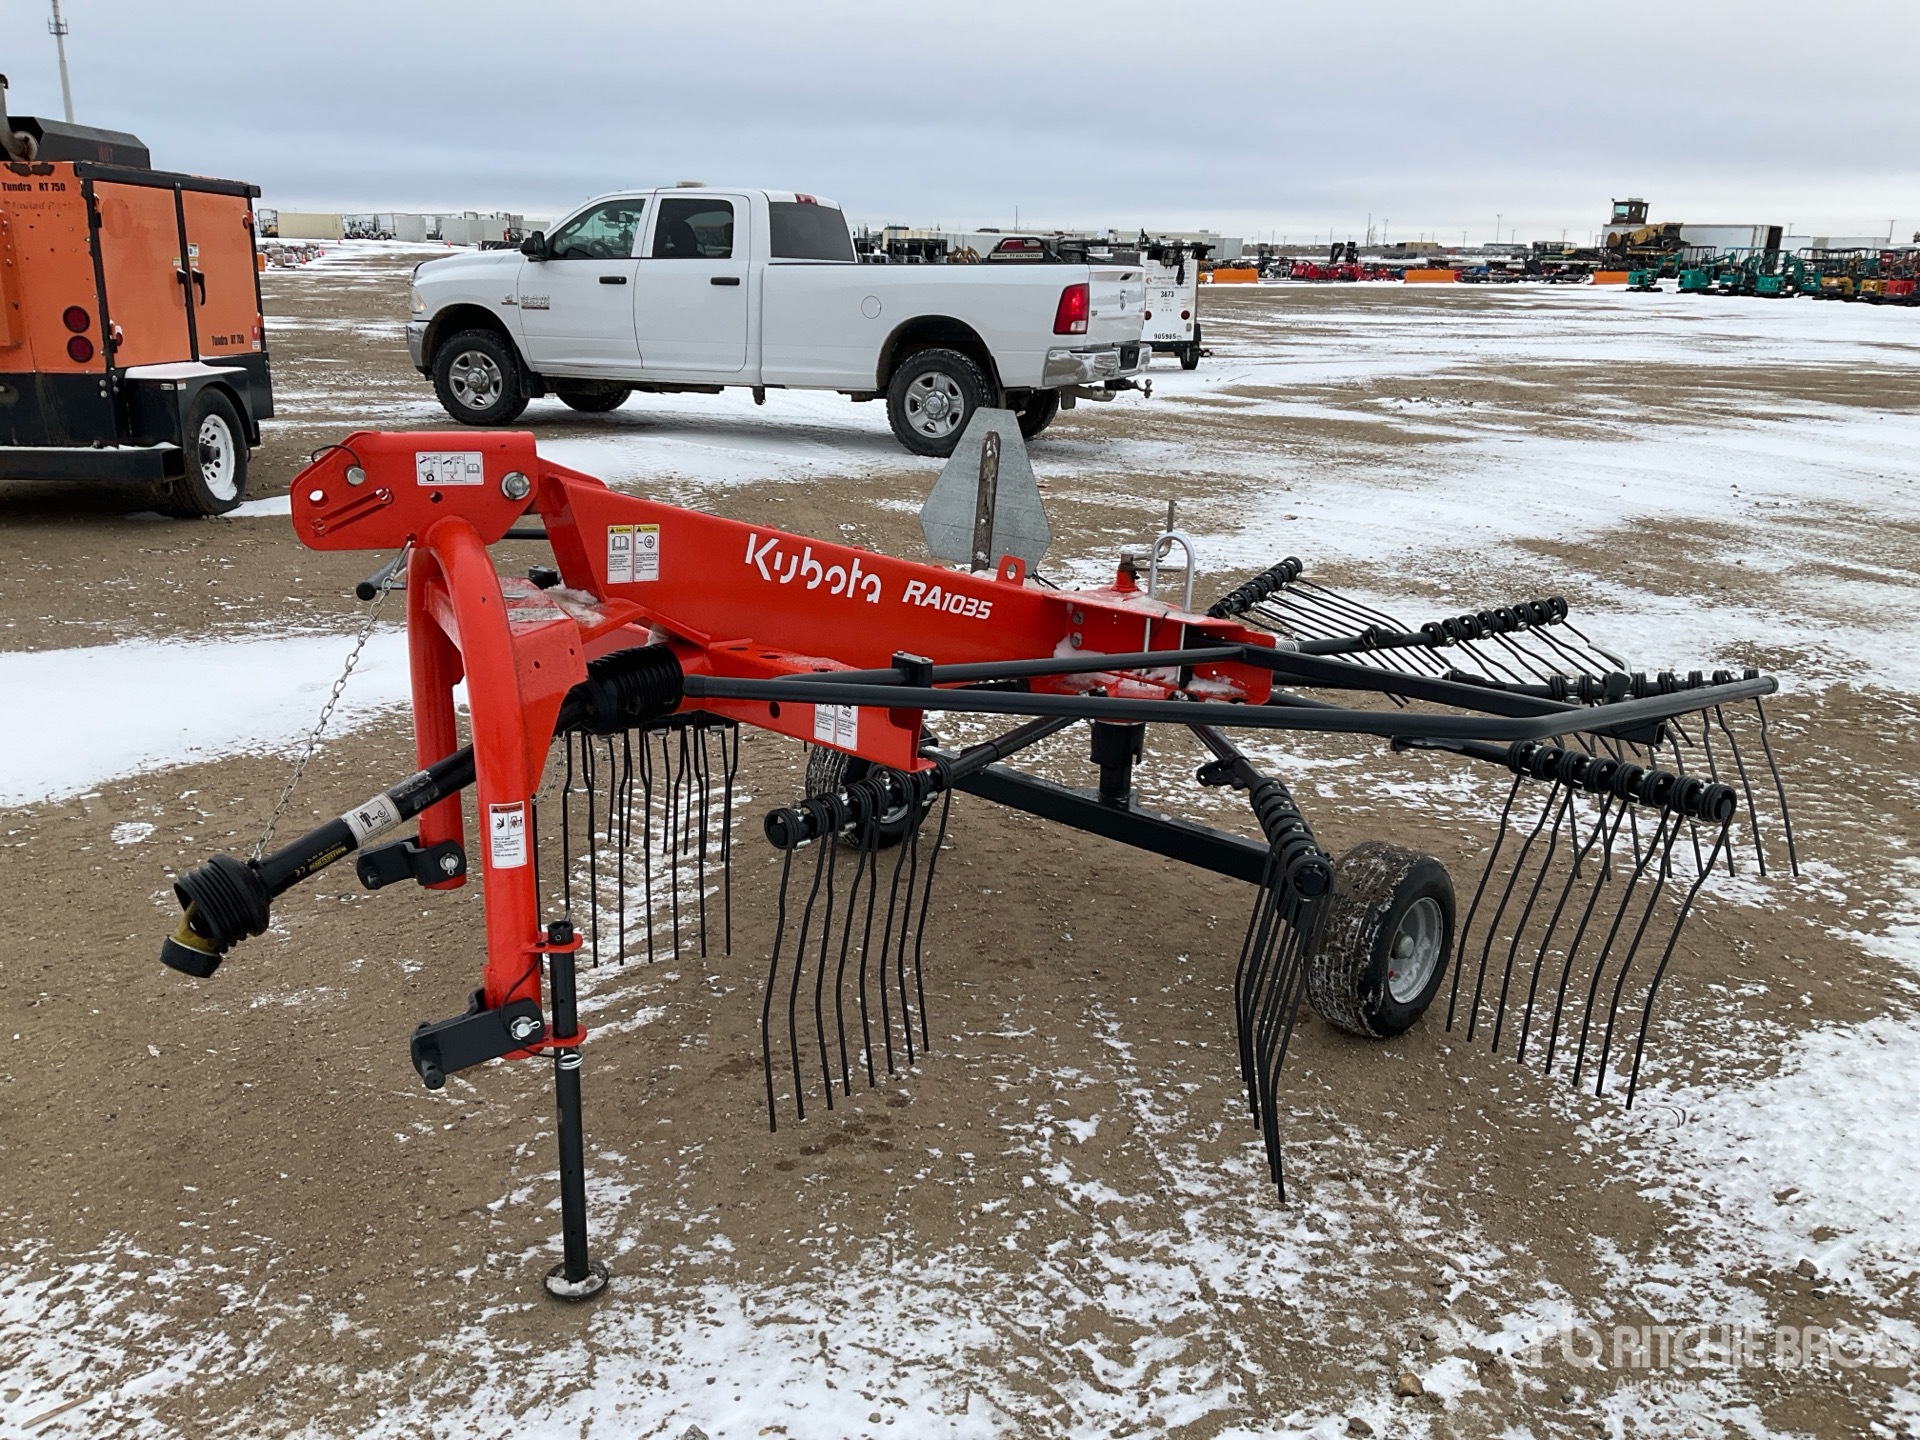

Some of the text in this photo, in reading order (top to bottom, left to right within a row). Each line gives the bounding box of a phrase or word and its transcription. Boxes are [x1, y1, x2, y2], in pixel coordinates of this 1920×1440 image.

[1, 182, 66, 192] Tundra RT 750
[1160, 290, 1175, 298] 3873
[745, 532, 882, 604] Kubota
[902, 579, 994, 620] RA1035
